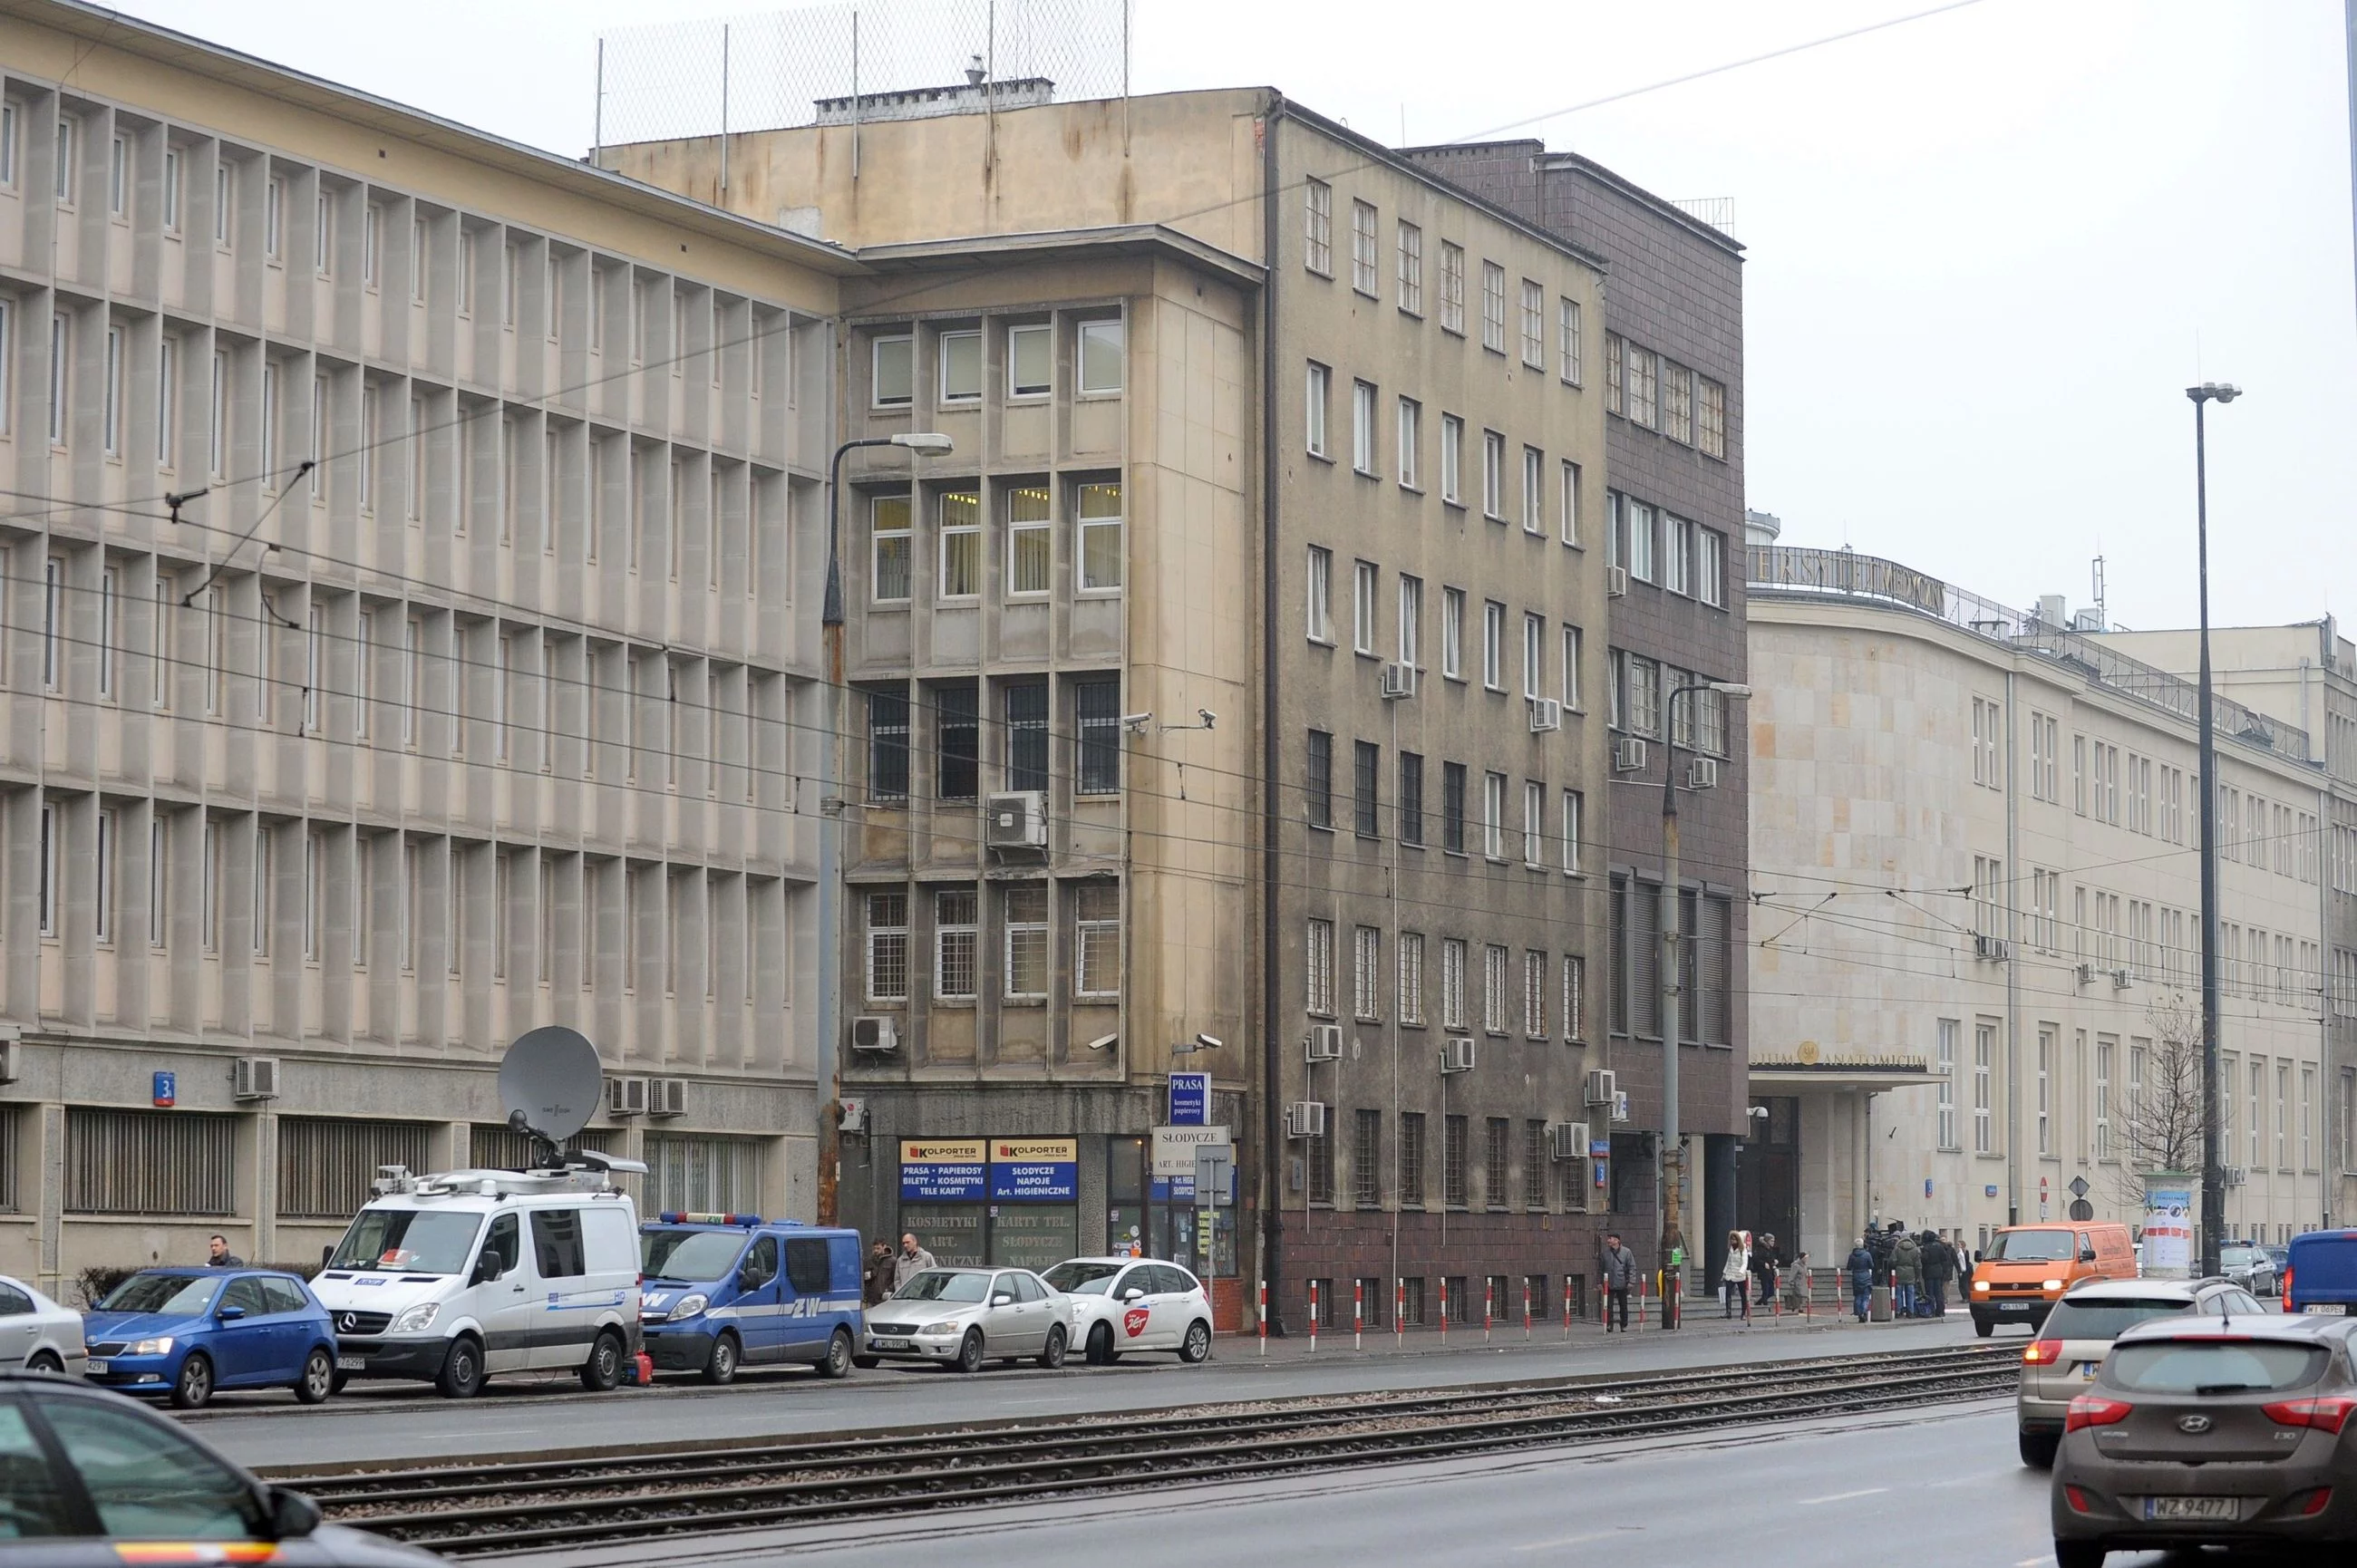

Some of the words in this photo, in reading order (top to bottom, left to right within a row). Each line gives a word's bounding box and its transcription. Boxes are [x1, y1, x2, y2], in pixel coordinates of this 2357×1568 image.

[1822, 1053, 1927, 1068] ANATOMICUM
[1171, 1079, 1203, 1090] PRASA
[1174, 1099, 1201, 1107] kosmetyki
[1174, 1107, 1201, 1116] papierosy
[1162, 1132, 1217, 1143] SŁODYCZE
[919, 1147, 976, 1158] KOLPORTER
[1010, 1146, 1068, 1157] KOLPORTER
[1158, 1159, 1174, 1168] ART.
[1176, 1159, 1196, 1168] HIGIE
[938, 1166, 983, 1176] PAPIEROSY
[1012, 1166, 1054, 1176] SŁODYCZE
[937, 1176, 984, 1186] KOSMETYKI
[1016, 1177, 1051, 1186] NAPOJE
[919, 1187, 937, 1195] TELE
[939, 1187, 965, 1195] KARTY
[997, 1187, 1013, 1195] Art.
[1014, 1186, 1071, 1195] HIGIENICZNE
[907, 1216, 977, 1227] KOSMETYKI
[997, 1216, 1039, 1227] KARTY
[1043, 1216, 1071, 1227] TEL.
[928, 1236, 957, 1247] ART.
[1003, 1236, 1062, 1248] SŁODYCZE
[935, 1255, 983, 1267] ENICZNE
[1009, 1256, 1056, 1267] NAPOJE
[642, 1292, 670, 1307] W
[792, 1297, 821, 1319] ZW
[2157, 1498, 2180, 1515] WZ
[2184, 1498, 2235, 1515] 9477J
